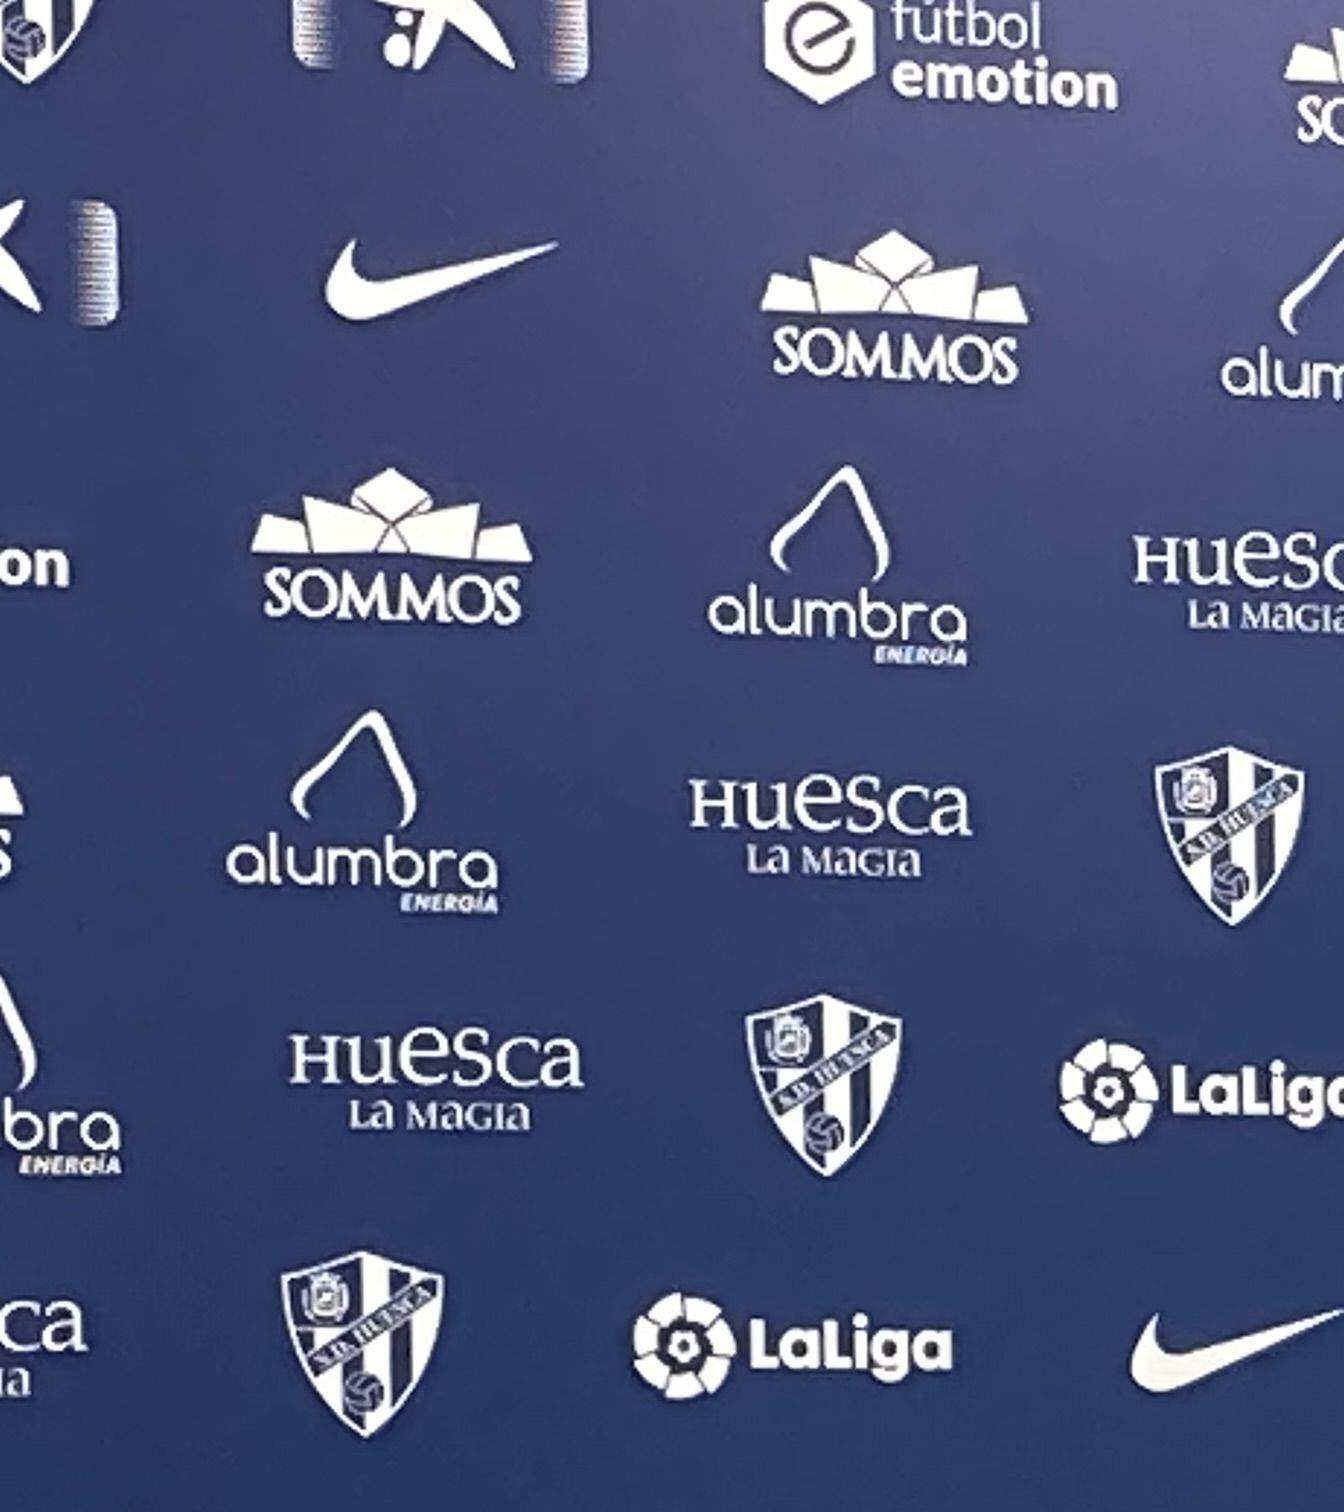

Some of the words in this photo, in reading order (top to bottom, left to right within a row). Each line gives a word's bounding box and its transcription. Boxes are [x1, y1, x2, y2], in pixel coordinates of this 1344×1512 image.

[892, 54, 1118, 110] emotion
[772, 324, 1020, 386] SOMMOS
[264, 566, 522, 627] SOMMOS
[708, 582, 968, 643] alumbra
[226, 831, 498, 889] alumbra
[400, 890, 499, 914] ENERGÍA
[750, 1312, 953, 1383] LaLiga
